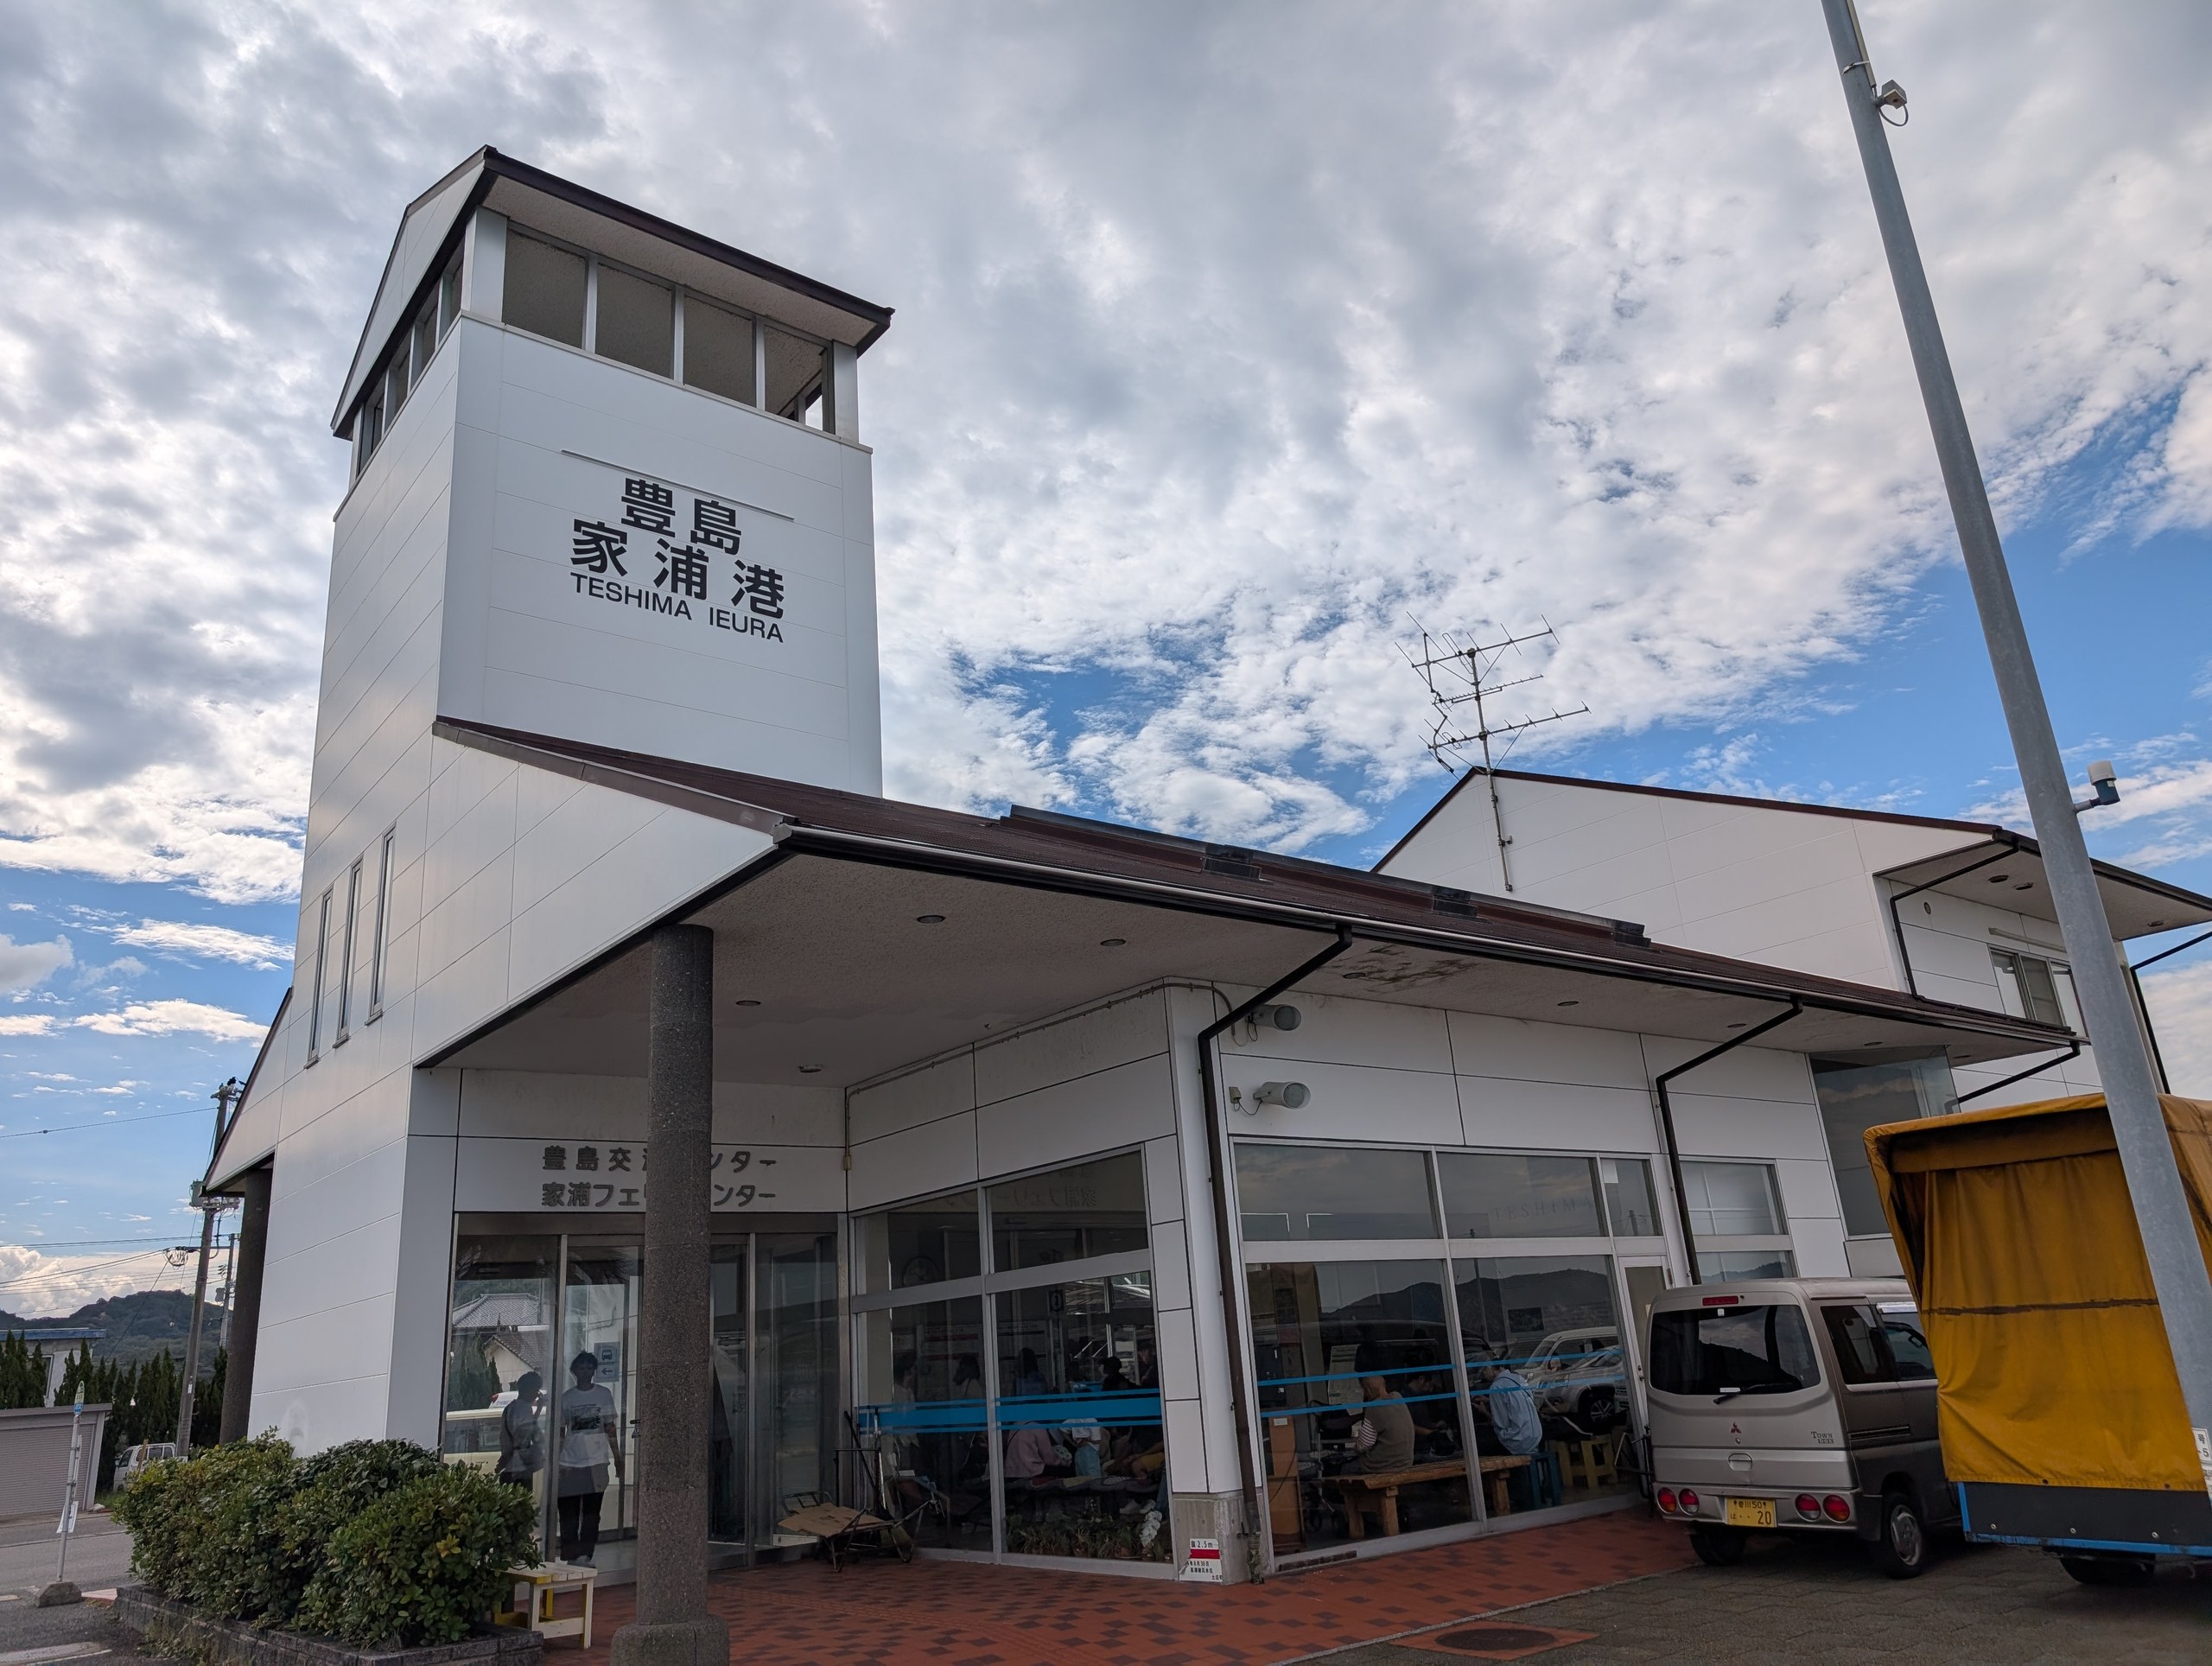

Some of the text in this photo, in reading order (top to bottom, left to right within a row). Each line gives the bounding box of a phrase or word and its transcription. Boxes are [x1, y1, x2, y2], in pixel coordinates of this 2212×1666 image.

[621, 477, 741, 556] 豊島
[569, 518, 785, 620] 家浦港
[569, 571, 784, 643] TESHIMA IEURA
[543, 1145, 777, 1173] 豊島交ンター
